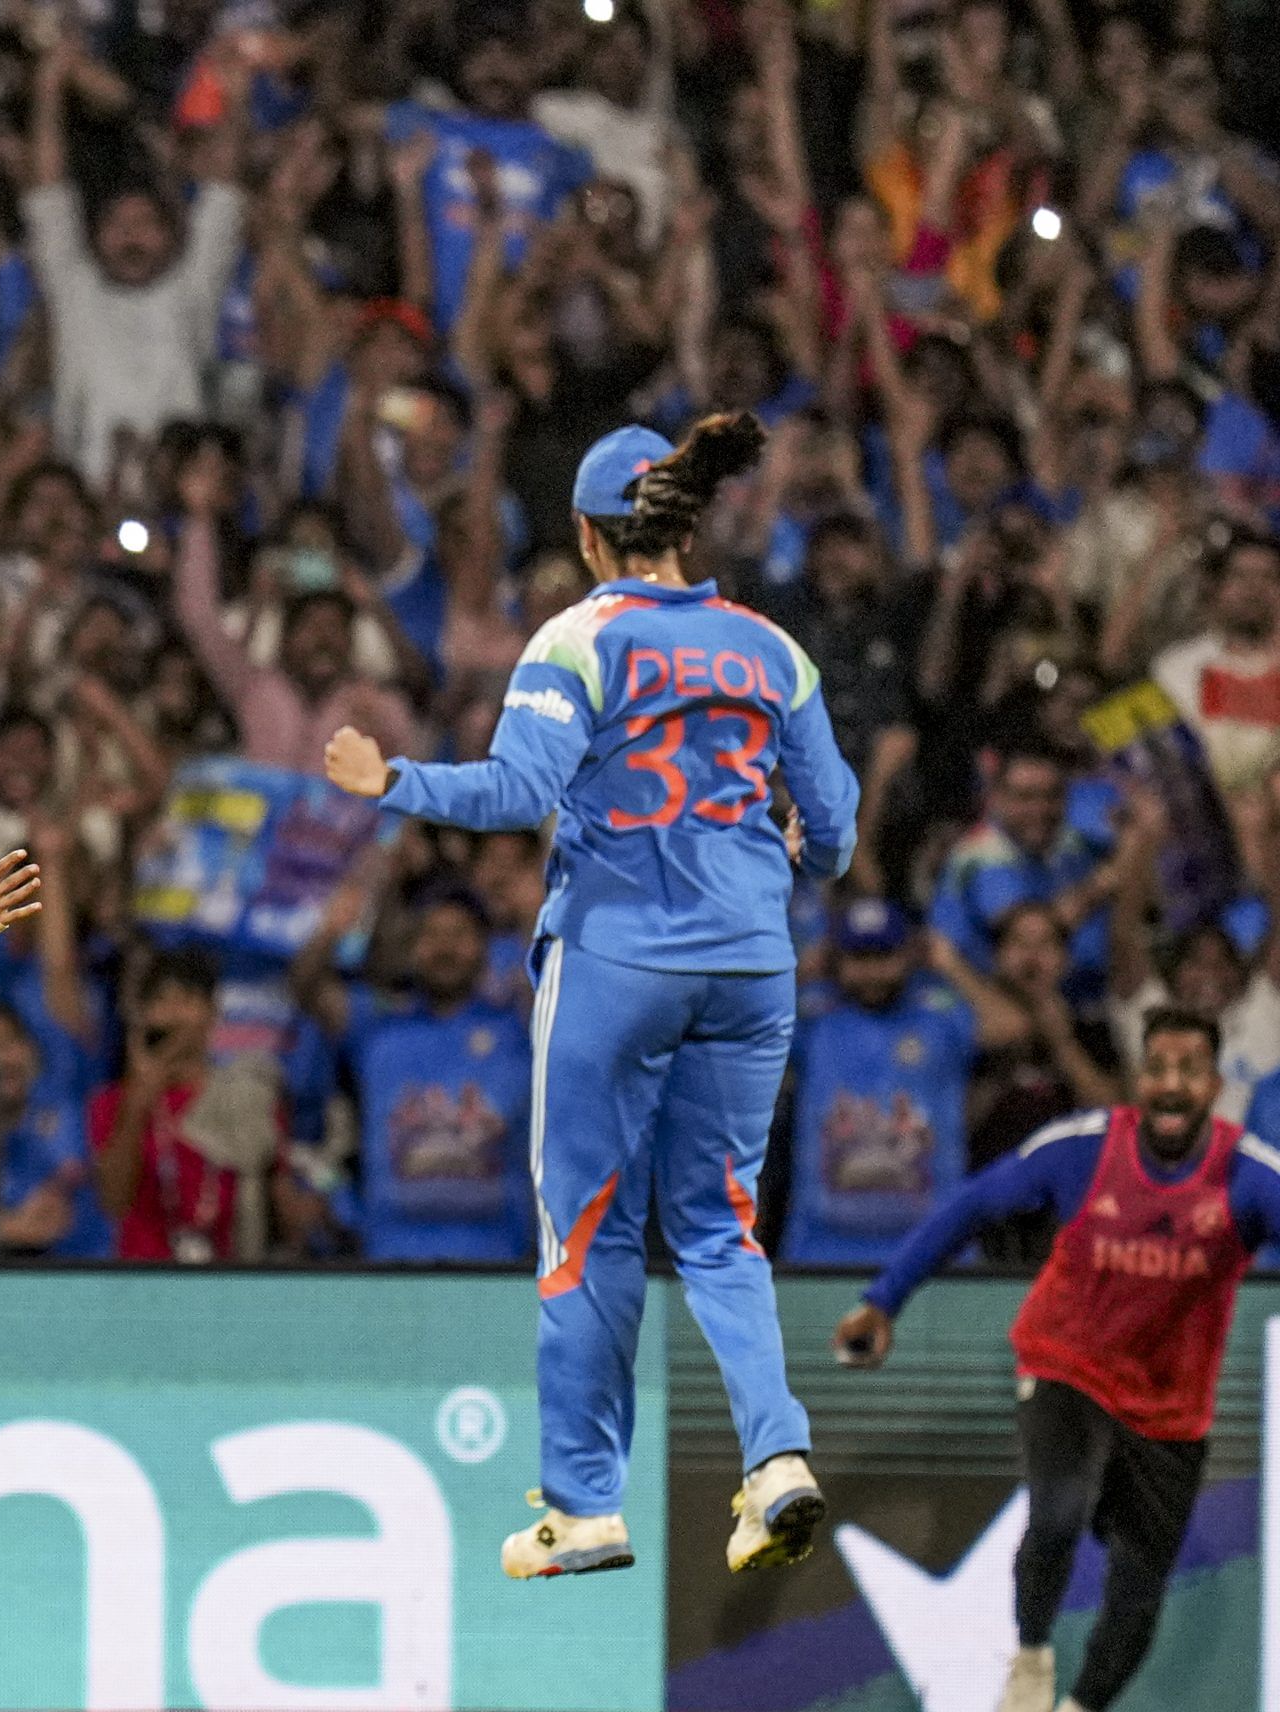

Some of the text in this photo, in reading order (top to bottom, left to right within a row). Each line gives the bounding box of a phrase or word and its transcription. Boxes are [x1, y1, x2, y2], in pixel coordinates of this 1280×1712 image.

[627, 646, 783, 703] DEOL
[608, 706, 773, 828] 33
[1092, 1235, 1209, 1279] INDIA
